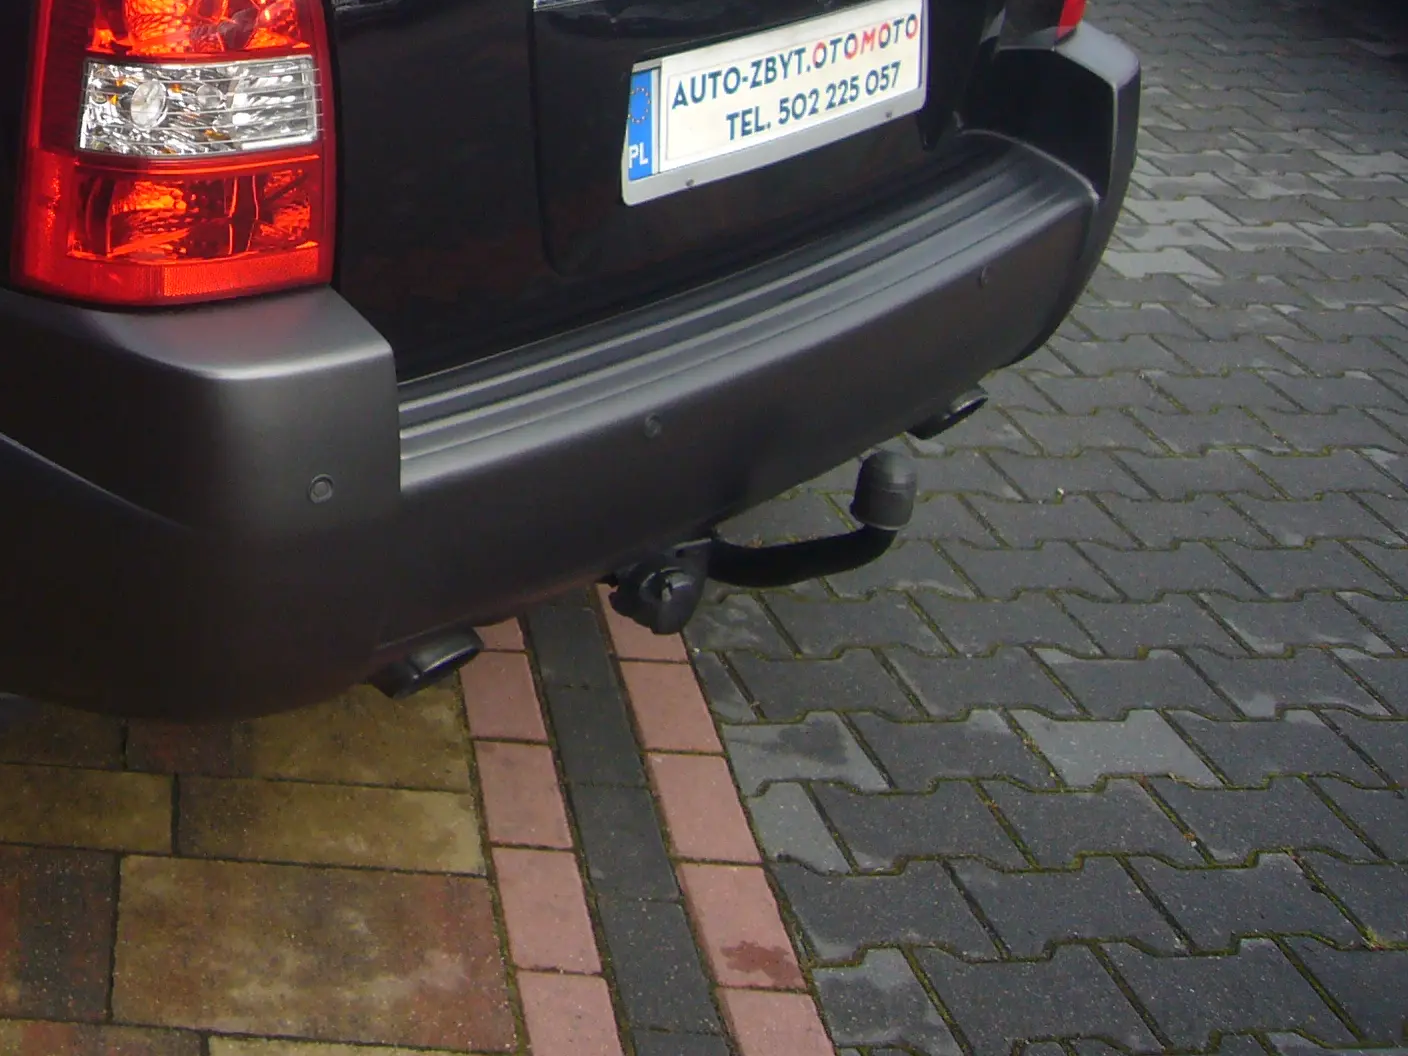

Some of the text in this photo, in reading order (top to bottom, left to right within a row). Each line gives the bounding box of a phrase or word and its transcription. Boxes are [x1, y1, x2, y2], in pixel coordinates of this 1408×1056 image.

[671, 13, 919, 110] AUTO-ZBYT.OTOMOTO
[726, 60, 901, 141] TEL. 502 225 057
[628, 142, 649, 170] PL
